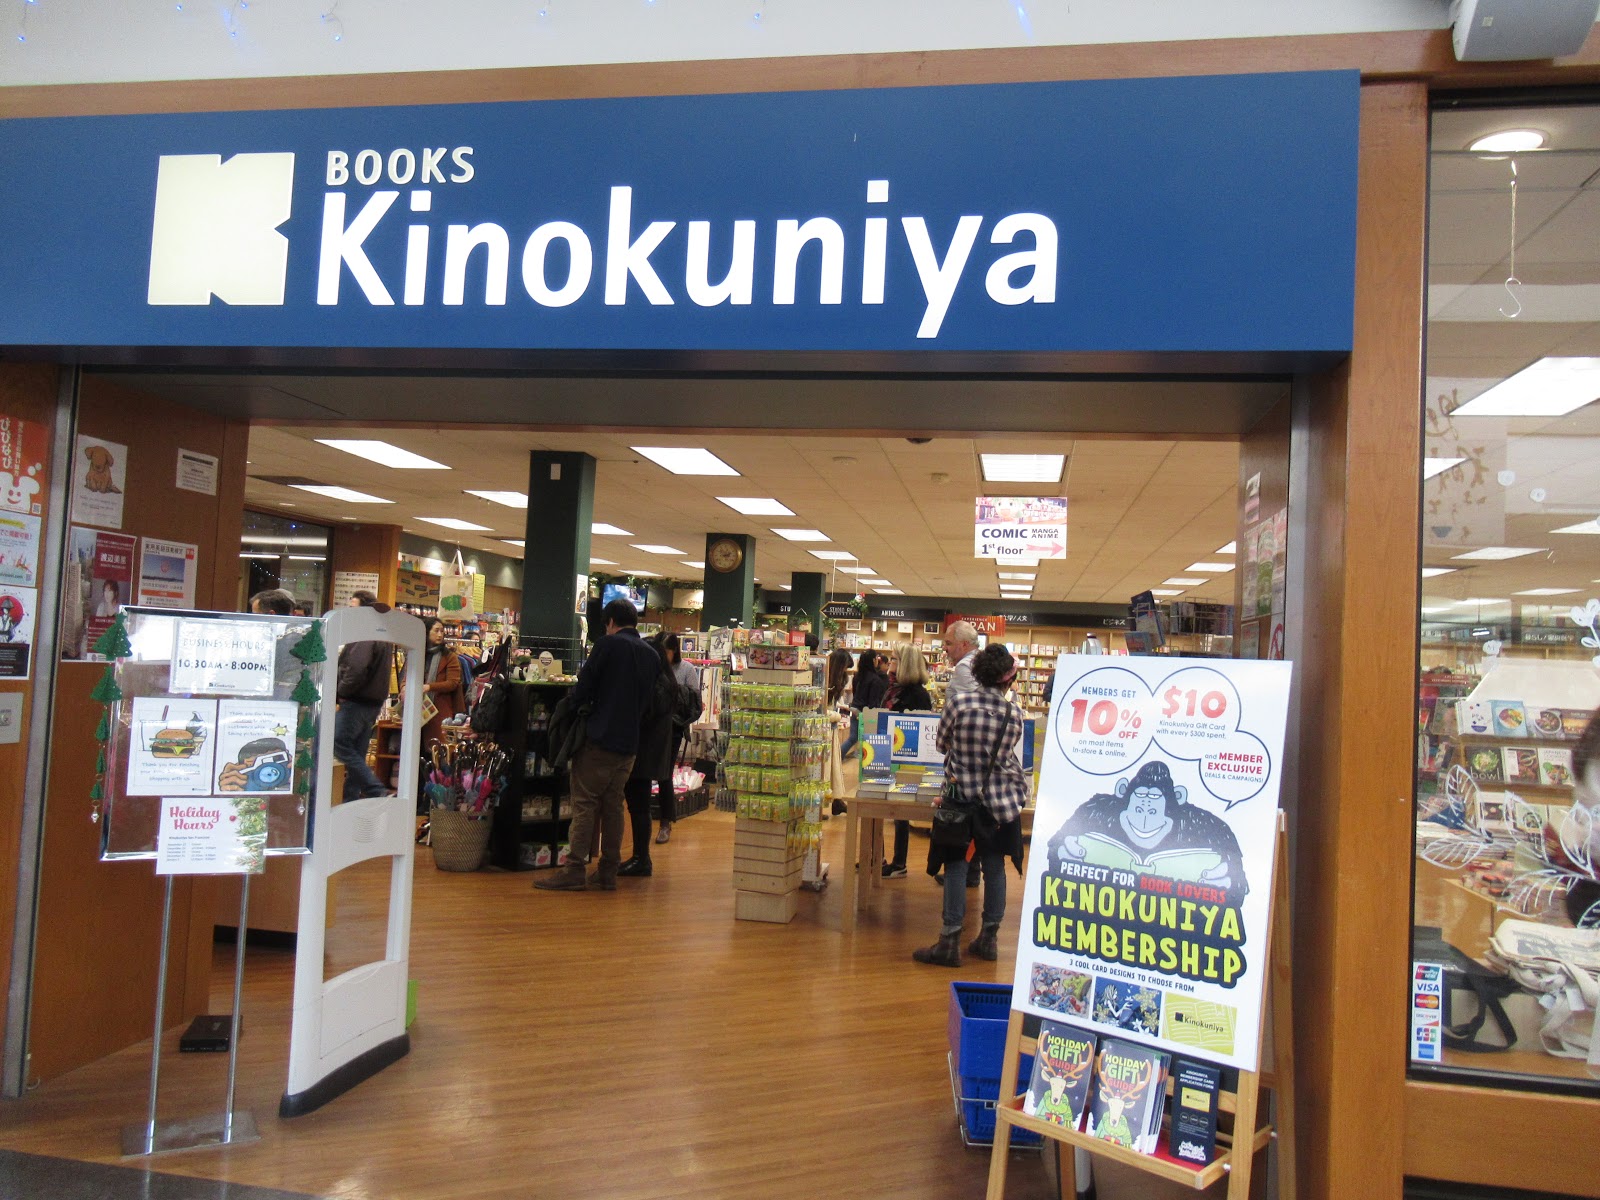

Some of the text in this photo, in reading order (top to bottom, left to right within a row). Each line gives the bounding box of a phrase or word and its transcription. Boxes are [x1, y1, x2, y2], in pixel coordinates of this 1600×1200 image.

[326, 147, 475, 185] BOOKS
[316, 180, 1059, 338] Kinokuniya
[981, 529, 1028, 538] COMIC
[981, 543, 1024, 555] 1st floor
[1103, 618, 1126, 626] ビジネス
[183, 638, 265, 650] BUSINESS HOURS
[179, 659, 222, 669] 10:30AM
[231, 661, 268, 671] 8:00PM
[1081, 686, 1136, 698] MEMBERS GET
[1162, 685, 1227, 719] $10
[1071, 699, 1142, 735] 10%
[1159, 720, 1194, 729] Kinokuniya
[1208, 723, 1226, 731] Card
[1118, 730, 1139, 739] OFF
[1105, 740, 1124, 748] items
[1219, 752, 1263, 763] MEMBER
[1207, 762, 1263, 775] EXCLUSIVE
[1470, 766, 1501, 780] bowl
[1227, 774, 1264, 783] CAMPAIGNS!
[170, 805, 221, 823] Holiday
[174, 819, 214, 830] Hours
[1060, 861, 1226, 905] PERFECT FOR BOOK LOVERS
[1044, 875, 1241, 941] KINOKUNIYA
[1036, 911, 1242, 983] MEMBERSHIP
[1069, 958, 1195, 993] 3 COOL CARD DESIGNS TO CHOOSE FROM
[1417, 983, 1440, 992] VISA
[1183, 1016, 1224, 1033] Kinokuniya
[1047, 1035, 1088, 1052] HOLIDAY
[1049, 1044, 1082, 1065] GIFT
[1048, 1058, 1077, 1071] GUIDE
[1105, 1053, 1146, 1071] HOLIDAY
[1107, 1063, 1140, 1084] GIFT
[1106, 1078, 1135, 1091] GUIDE
